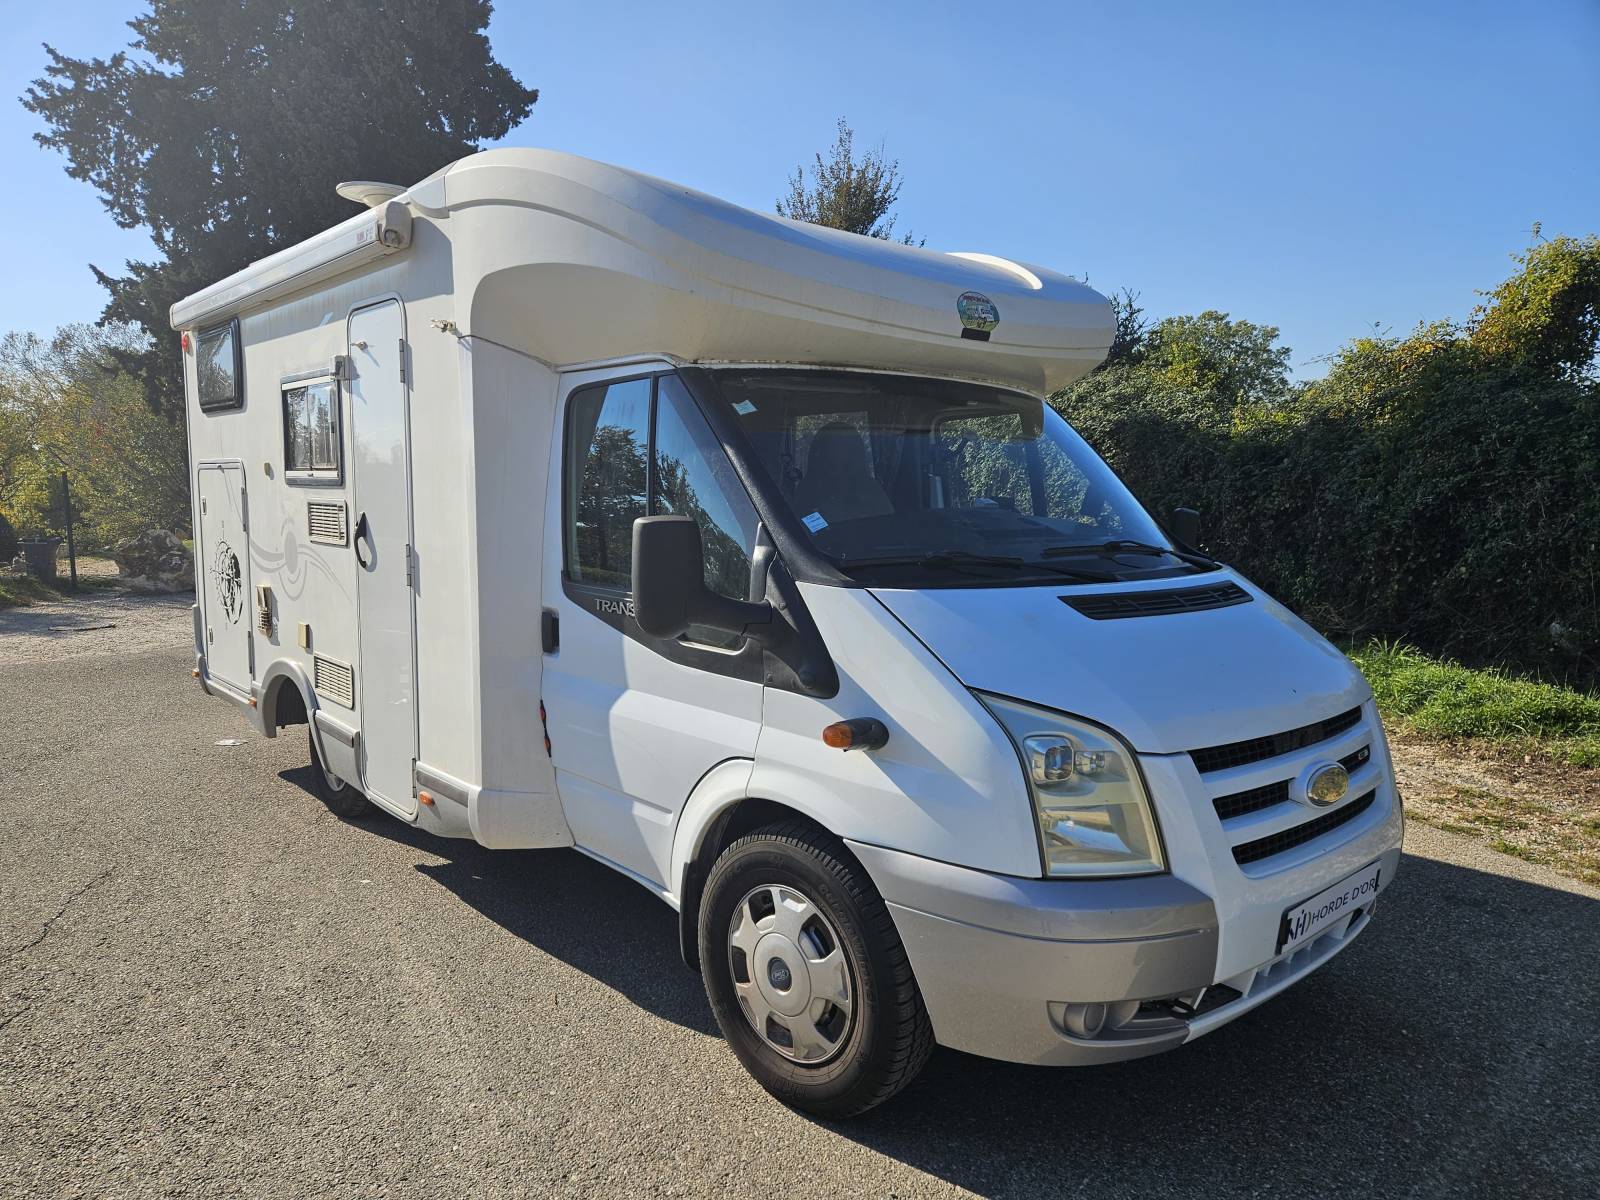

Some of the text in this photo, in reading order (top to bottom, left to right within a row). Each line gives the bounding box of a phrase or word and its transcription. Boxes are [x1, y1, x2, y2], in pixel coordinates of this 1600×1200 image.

[594, 598, 636, 617] TRANS
[1312, 892, 1349, 924] HORDE
[1351, 877, 1377, 897] D'OR
